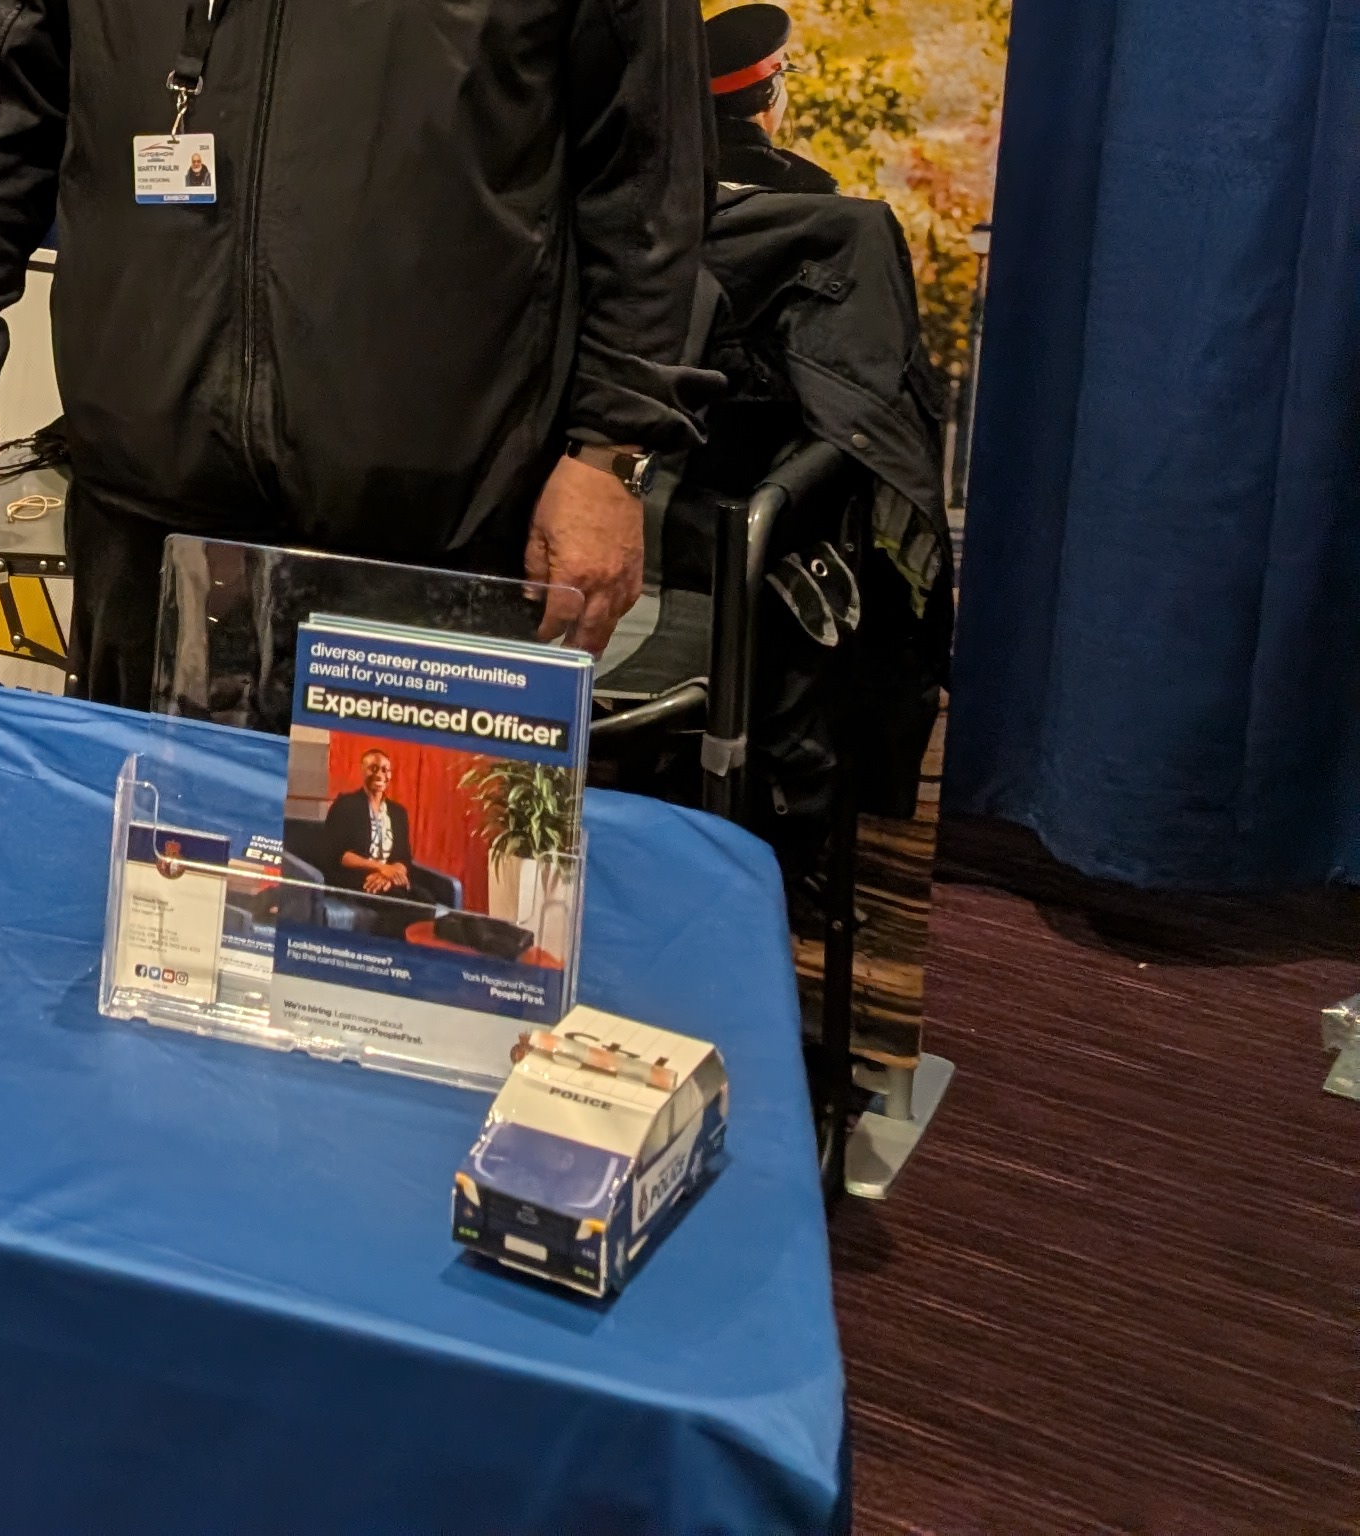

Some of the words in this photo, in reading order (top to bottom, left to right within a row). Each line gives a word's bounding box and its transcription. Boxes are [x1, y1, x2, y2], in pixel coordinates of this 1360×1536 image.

[309, 662, 350, 680] await
[351, 666, 374, 682] for
[374, 672, 404, 689] you
[404, 676, 424, 690] as
[425, 680, 448, 694] an:
[311, 643, 366, 663] diverse
[367, 652, 418, 670] career
[420, 660, 527, 688] opportunities
[306, 685, 467, 732] Experienced
[471, 711, 562, 747] Officer
[288, 938, 322, 954] Looking
[462, 971, 480, 983] York
[481, 975, 518, 989] Regional
[519, 981, 545, 995] Police
[490, 986, 521, 1001] People
[549, 1086, 613, 1111] POLICE
